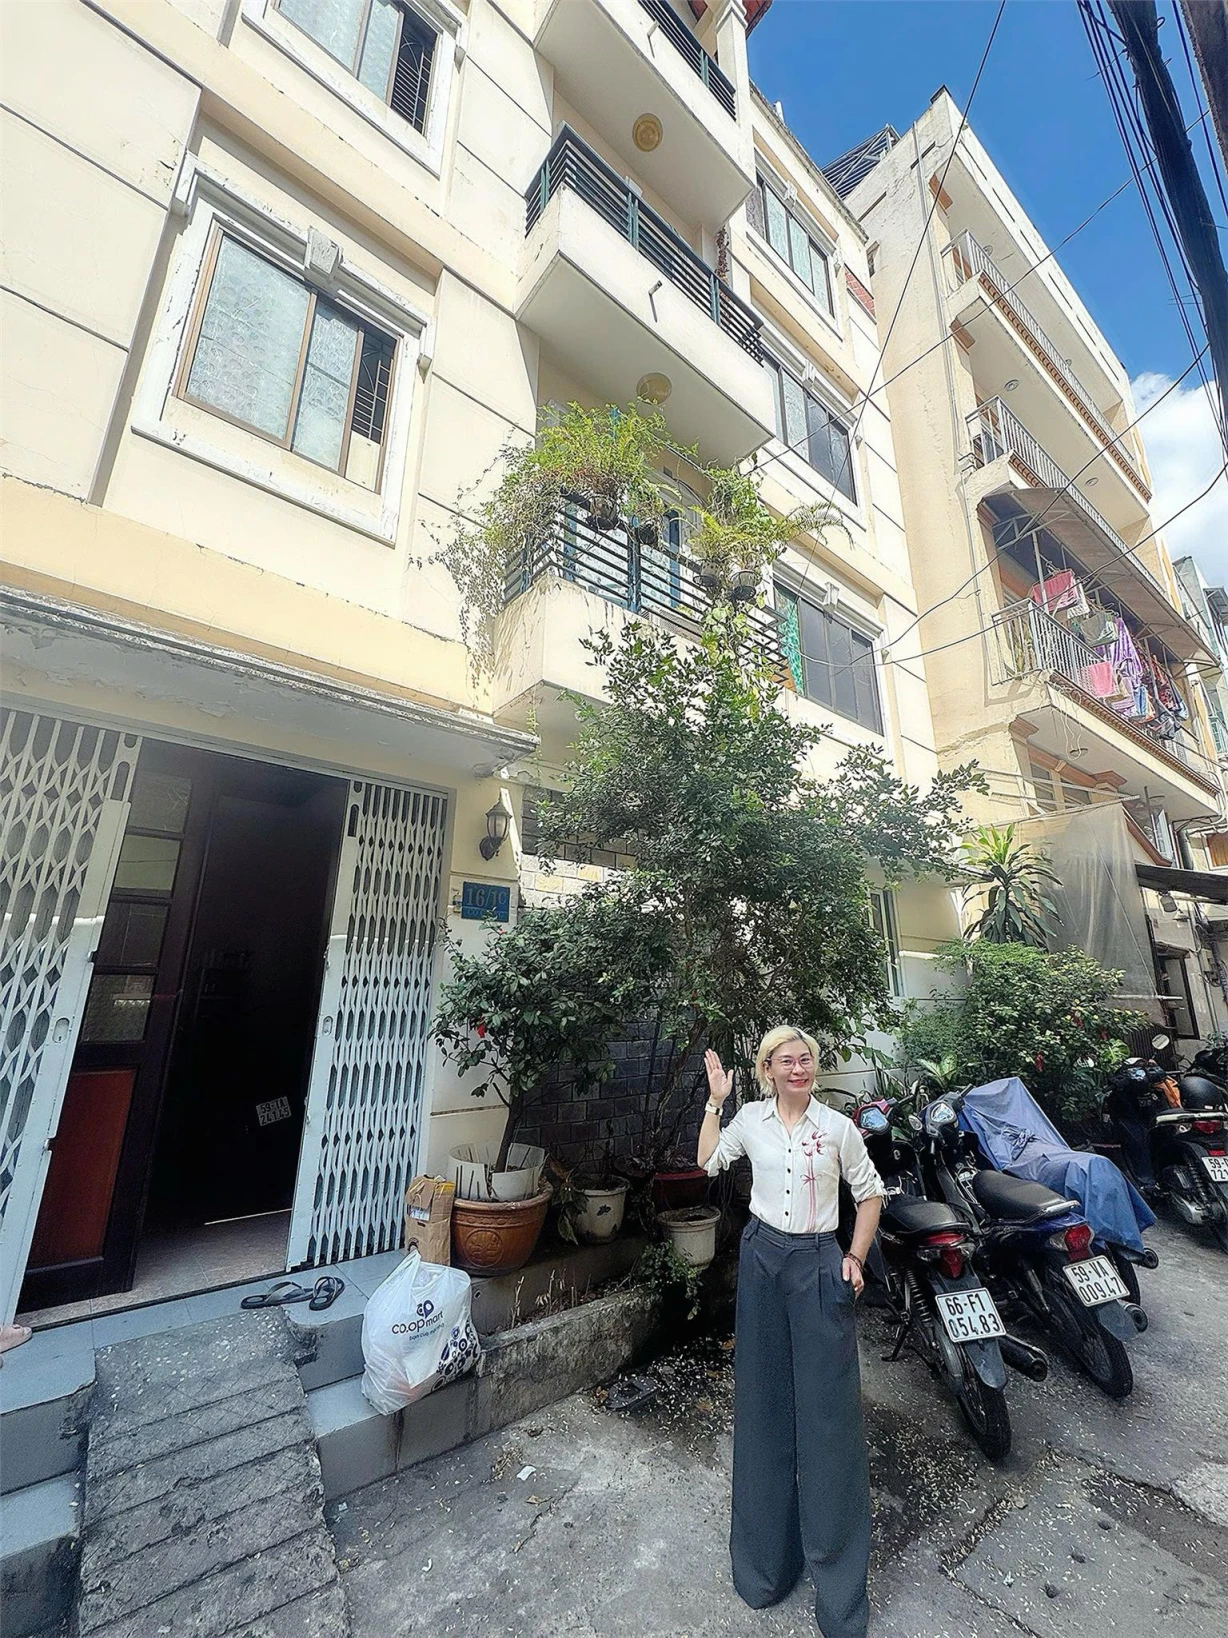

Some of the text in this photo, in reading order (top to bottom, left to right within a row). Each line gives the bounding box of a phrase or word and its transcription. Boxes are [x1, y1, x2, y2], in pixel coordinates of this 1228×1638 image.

[1072, 1260, 1109, 1283] 59-VA
[1079, 1277, 1123, 1303] 009.47
[946, 1294, 986, 1316] 66-F1
[949, 1314, 1000, 1338] 054.83
